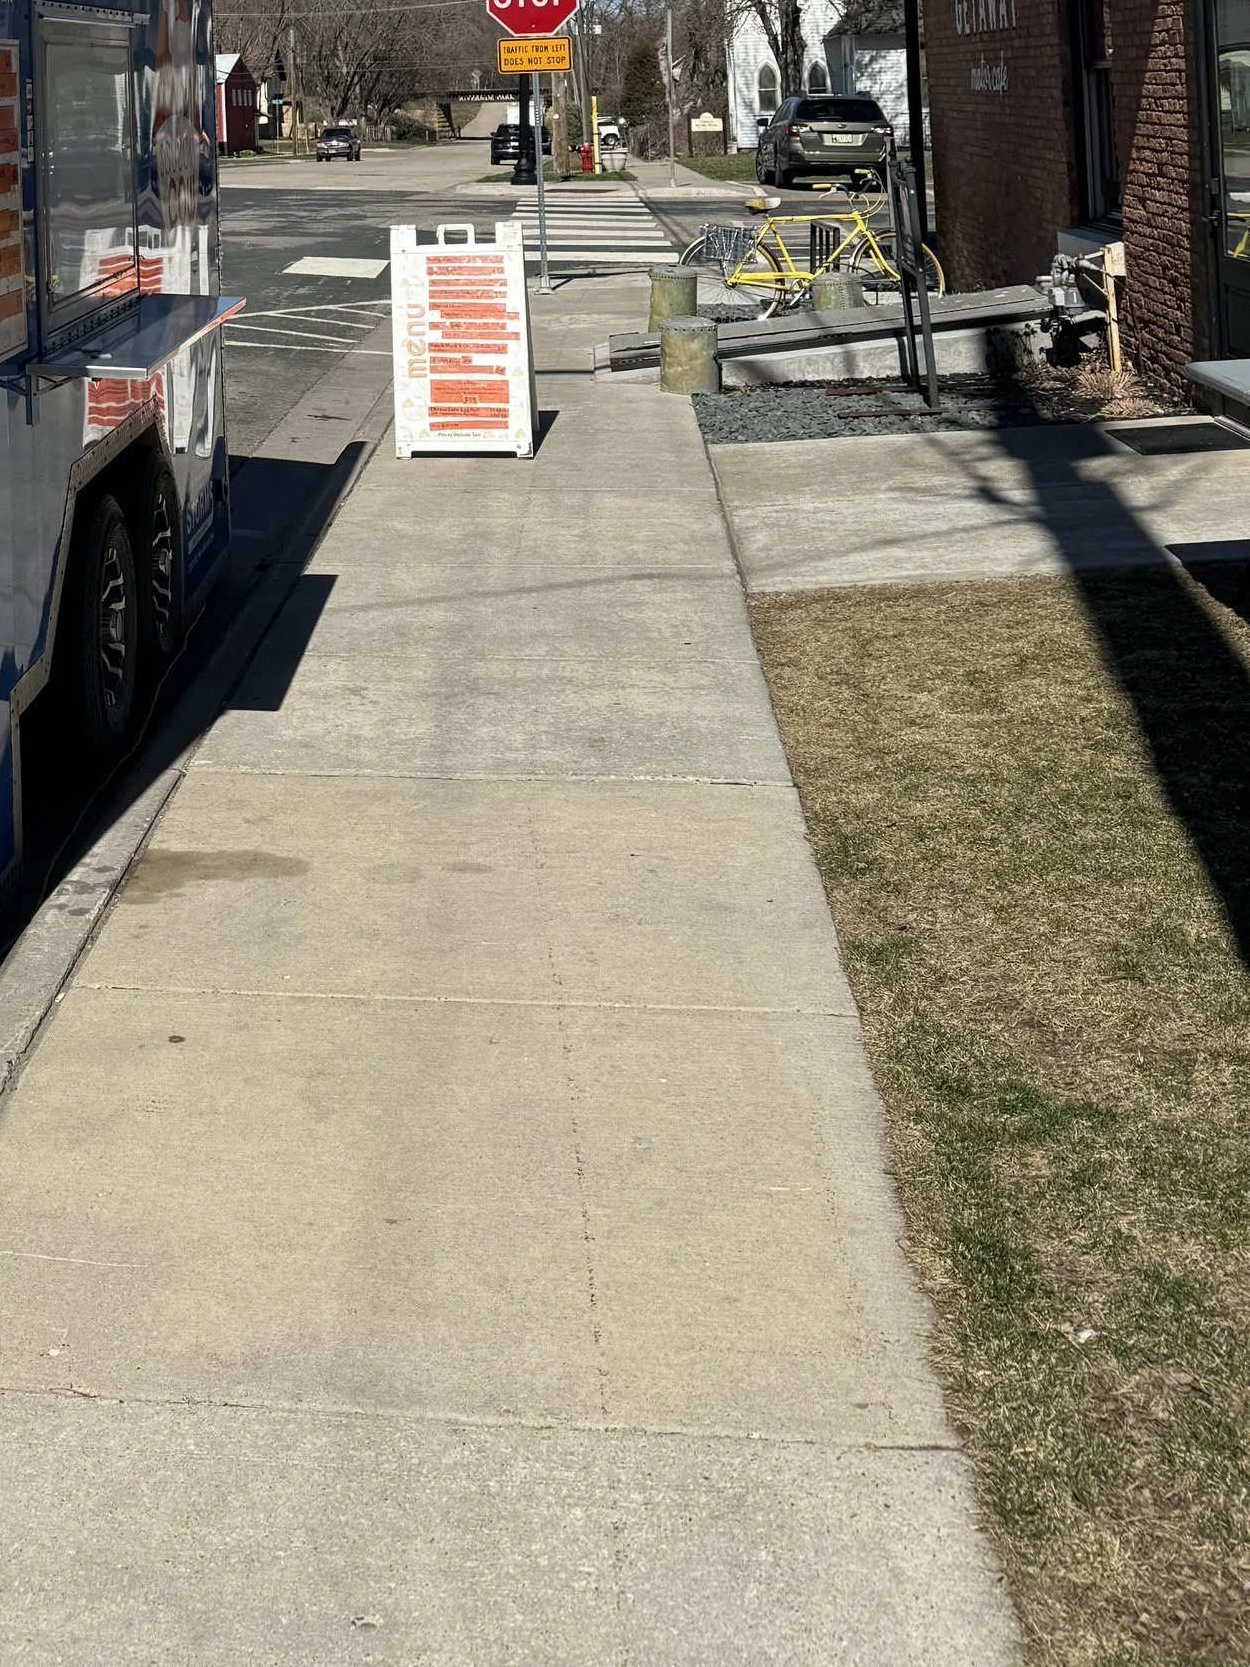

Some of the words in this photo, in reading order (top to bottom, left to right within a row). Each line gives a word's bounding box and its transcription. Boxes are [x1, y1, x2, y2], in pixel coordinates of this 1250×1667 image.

[503, 45, 529, 54] TRAFFIC
[531, 44, 549, 53] FROM
[551, 43, 566, 52] LEFT
[503, 57, 524, 66] DOES
[527, 56, 542, 65] NOT
[546, 55, 566, 64] STOP
[407, 302, 429, 379] menu
